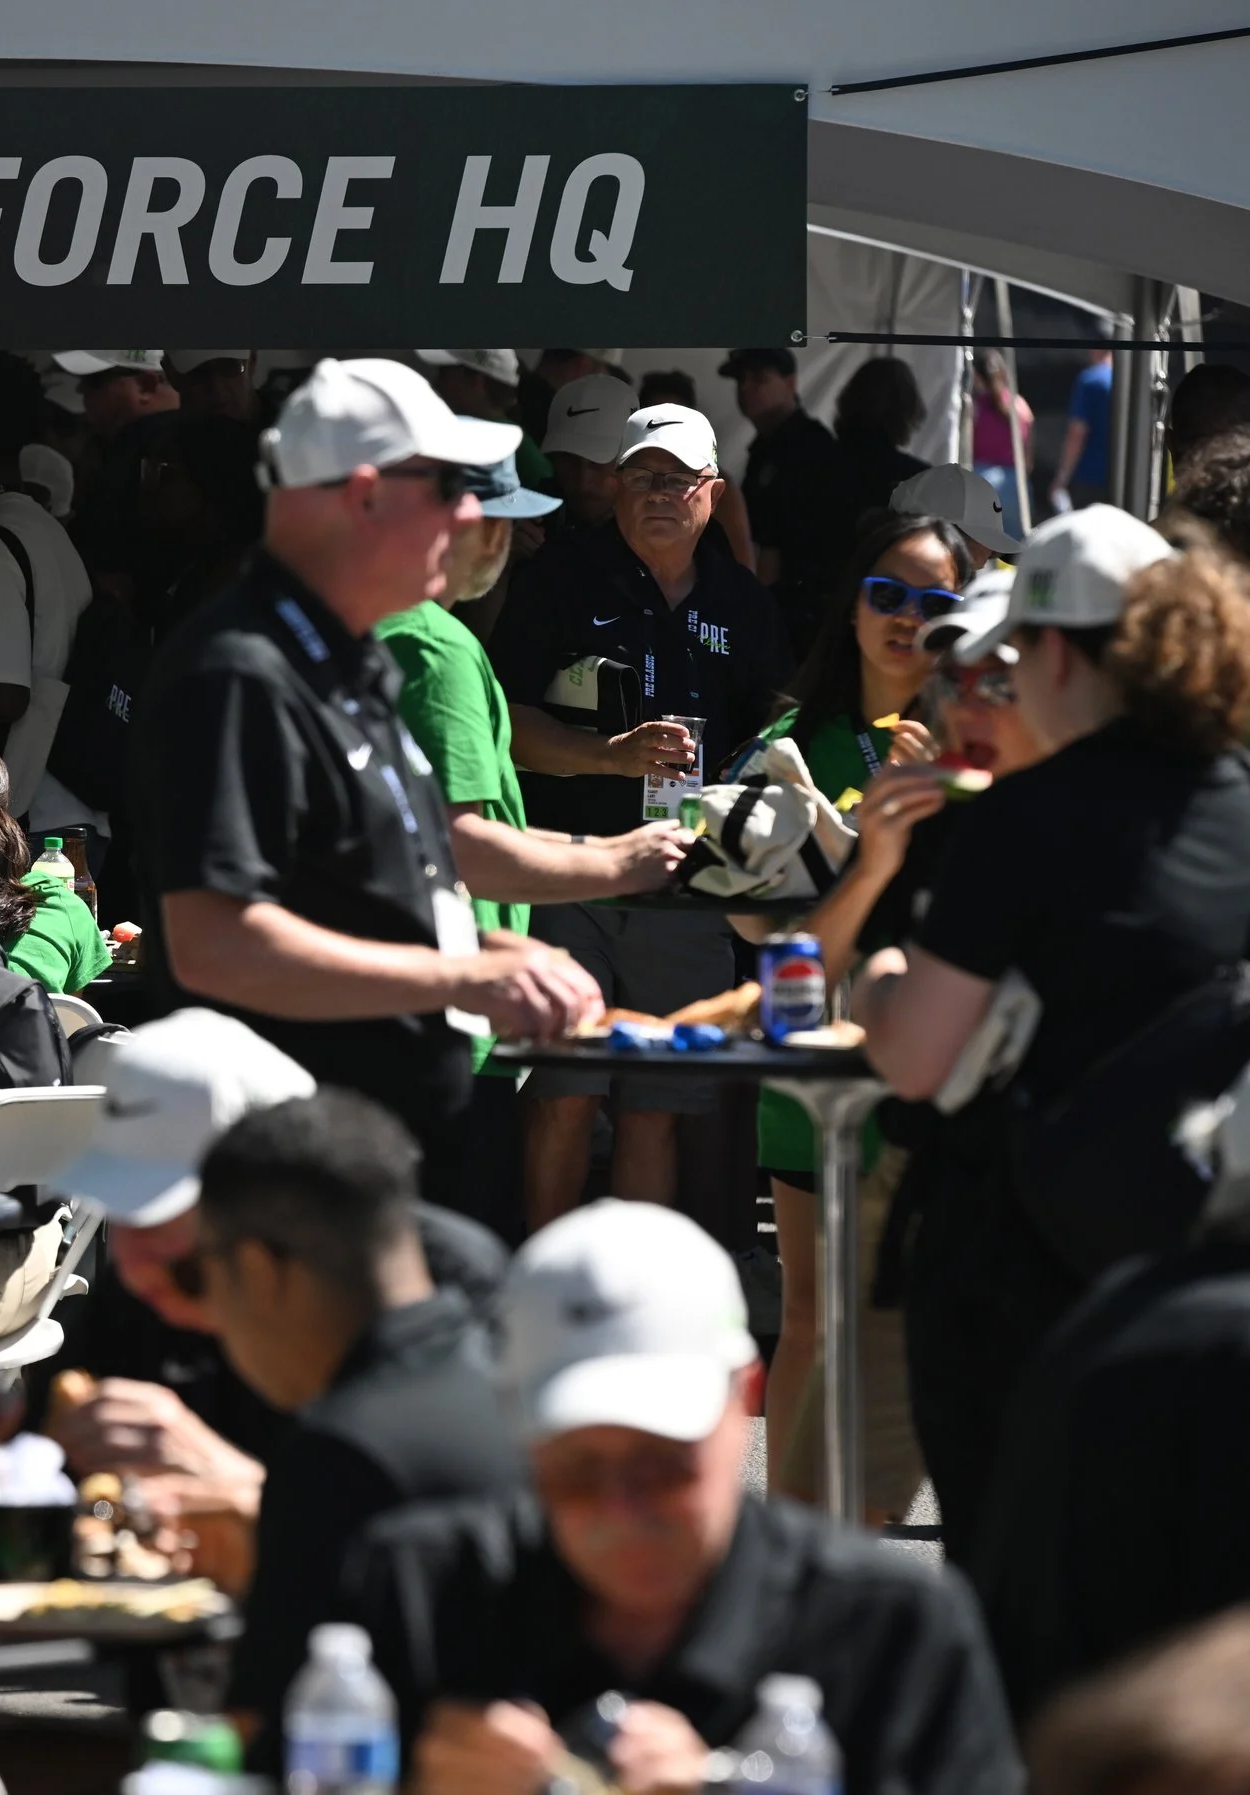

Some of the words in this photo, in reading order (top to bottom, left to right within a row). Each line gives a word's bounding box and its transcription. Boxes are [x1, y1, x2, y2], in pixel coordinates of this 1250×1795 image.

[438, 153, 646, 292] HQ
[700, 621, 730, 656] PRE
[108, 683, 132, 723] PRE
[644, 681, 655, 698] PRE
